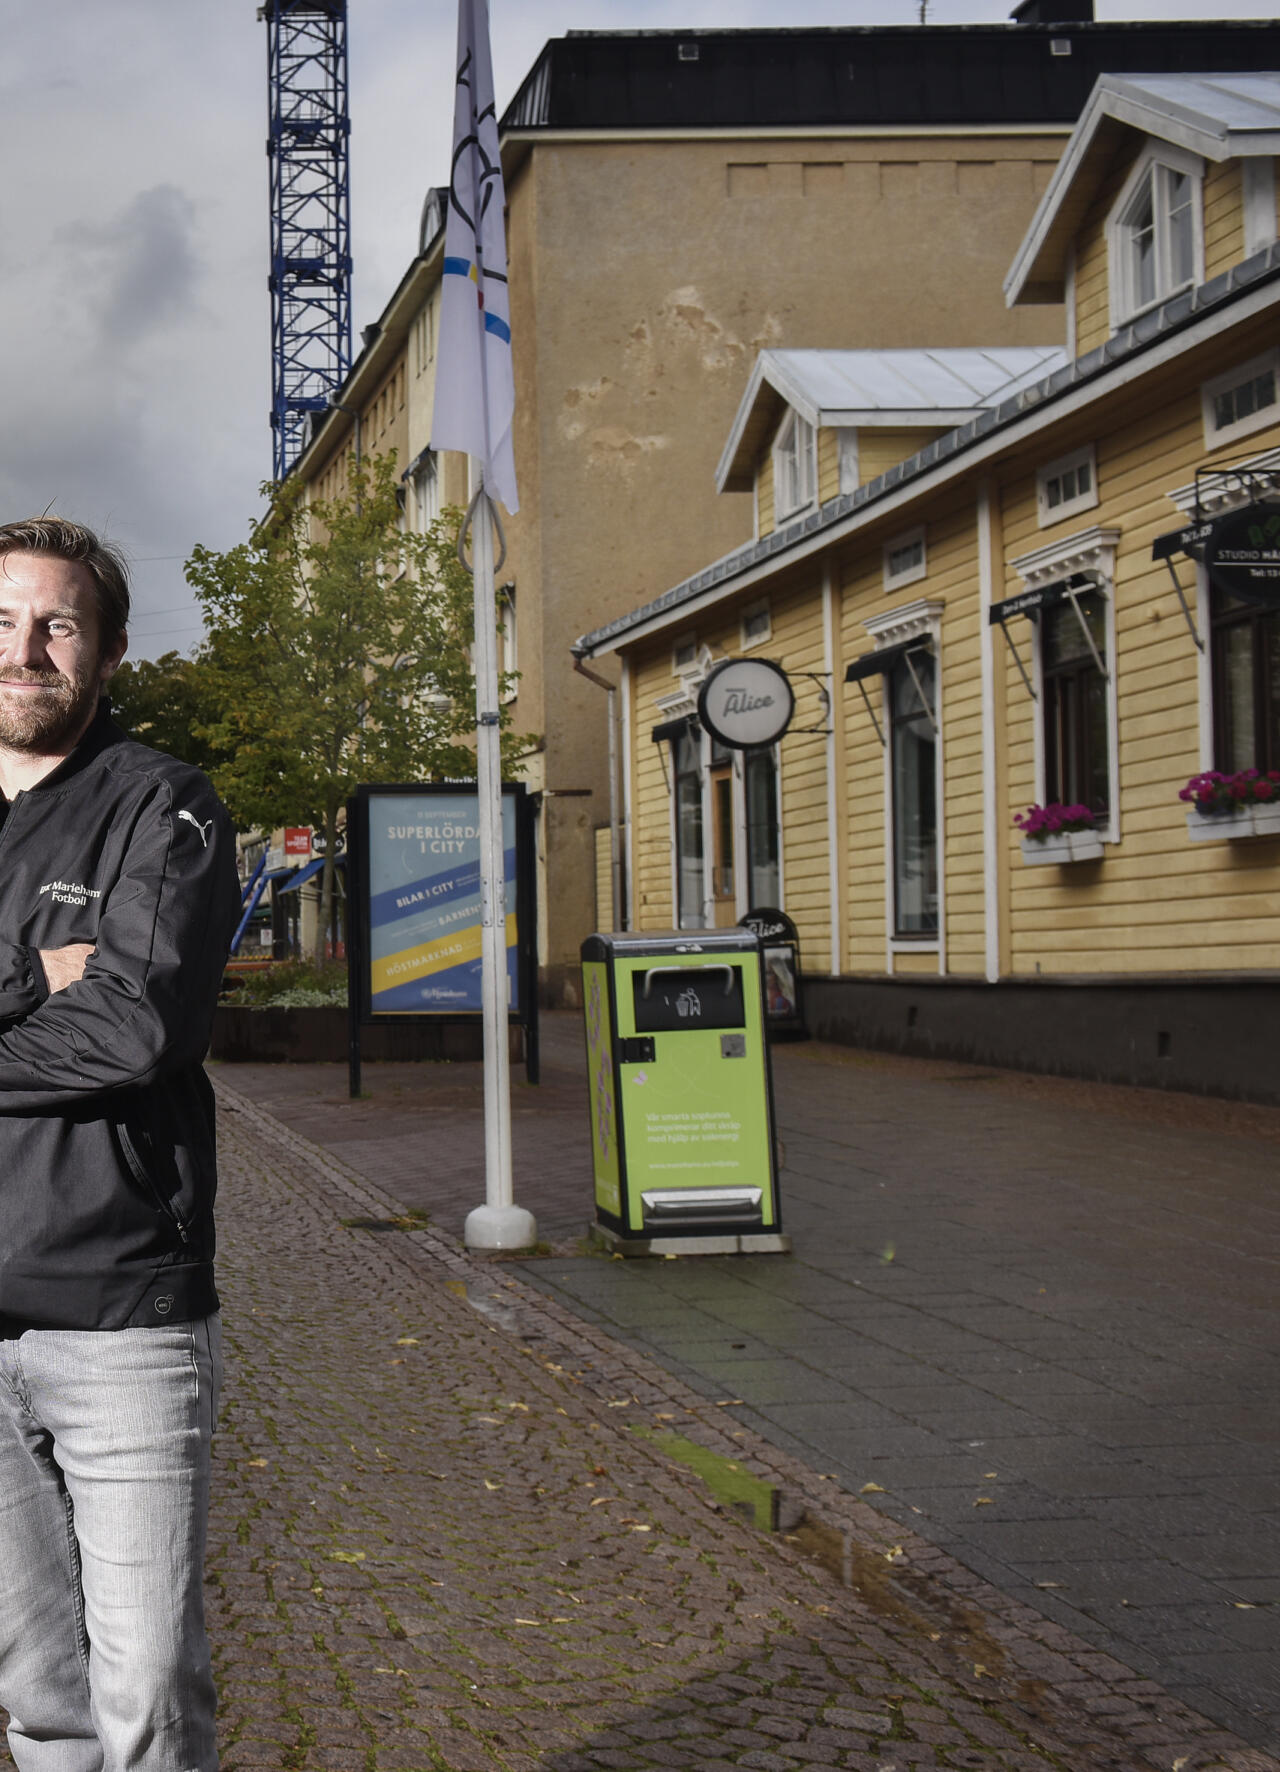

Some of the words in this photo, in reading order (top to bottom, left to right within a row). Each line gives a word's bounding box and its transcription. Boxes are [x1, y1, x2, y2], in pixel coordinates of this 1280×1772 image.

[1217, 549, 1261, 560] STUDIO
[723, 688, 775, 718] Alice
[387, 822, 481, 840] SUPERLÖRDA
[421, 841, 426, 853] I
[430, 841, 465, 854] CITY
[52, 891, 87, 906] Fotboll
[396, 891, 425, 908] BILAR
[425, 889, 431, 897] I
[431, 880, 455, 896] CITY
